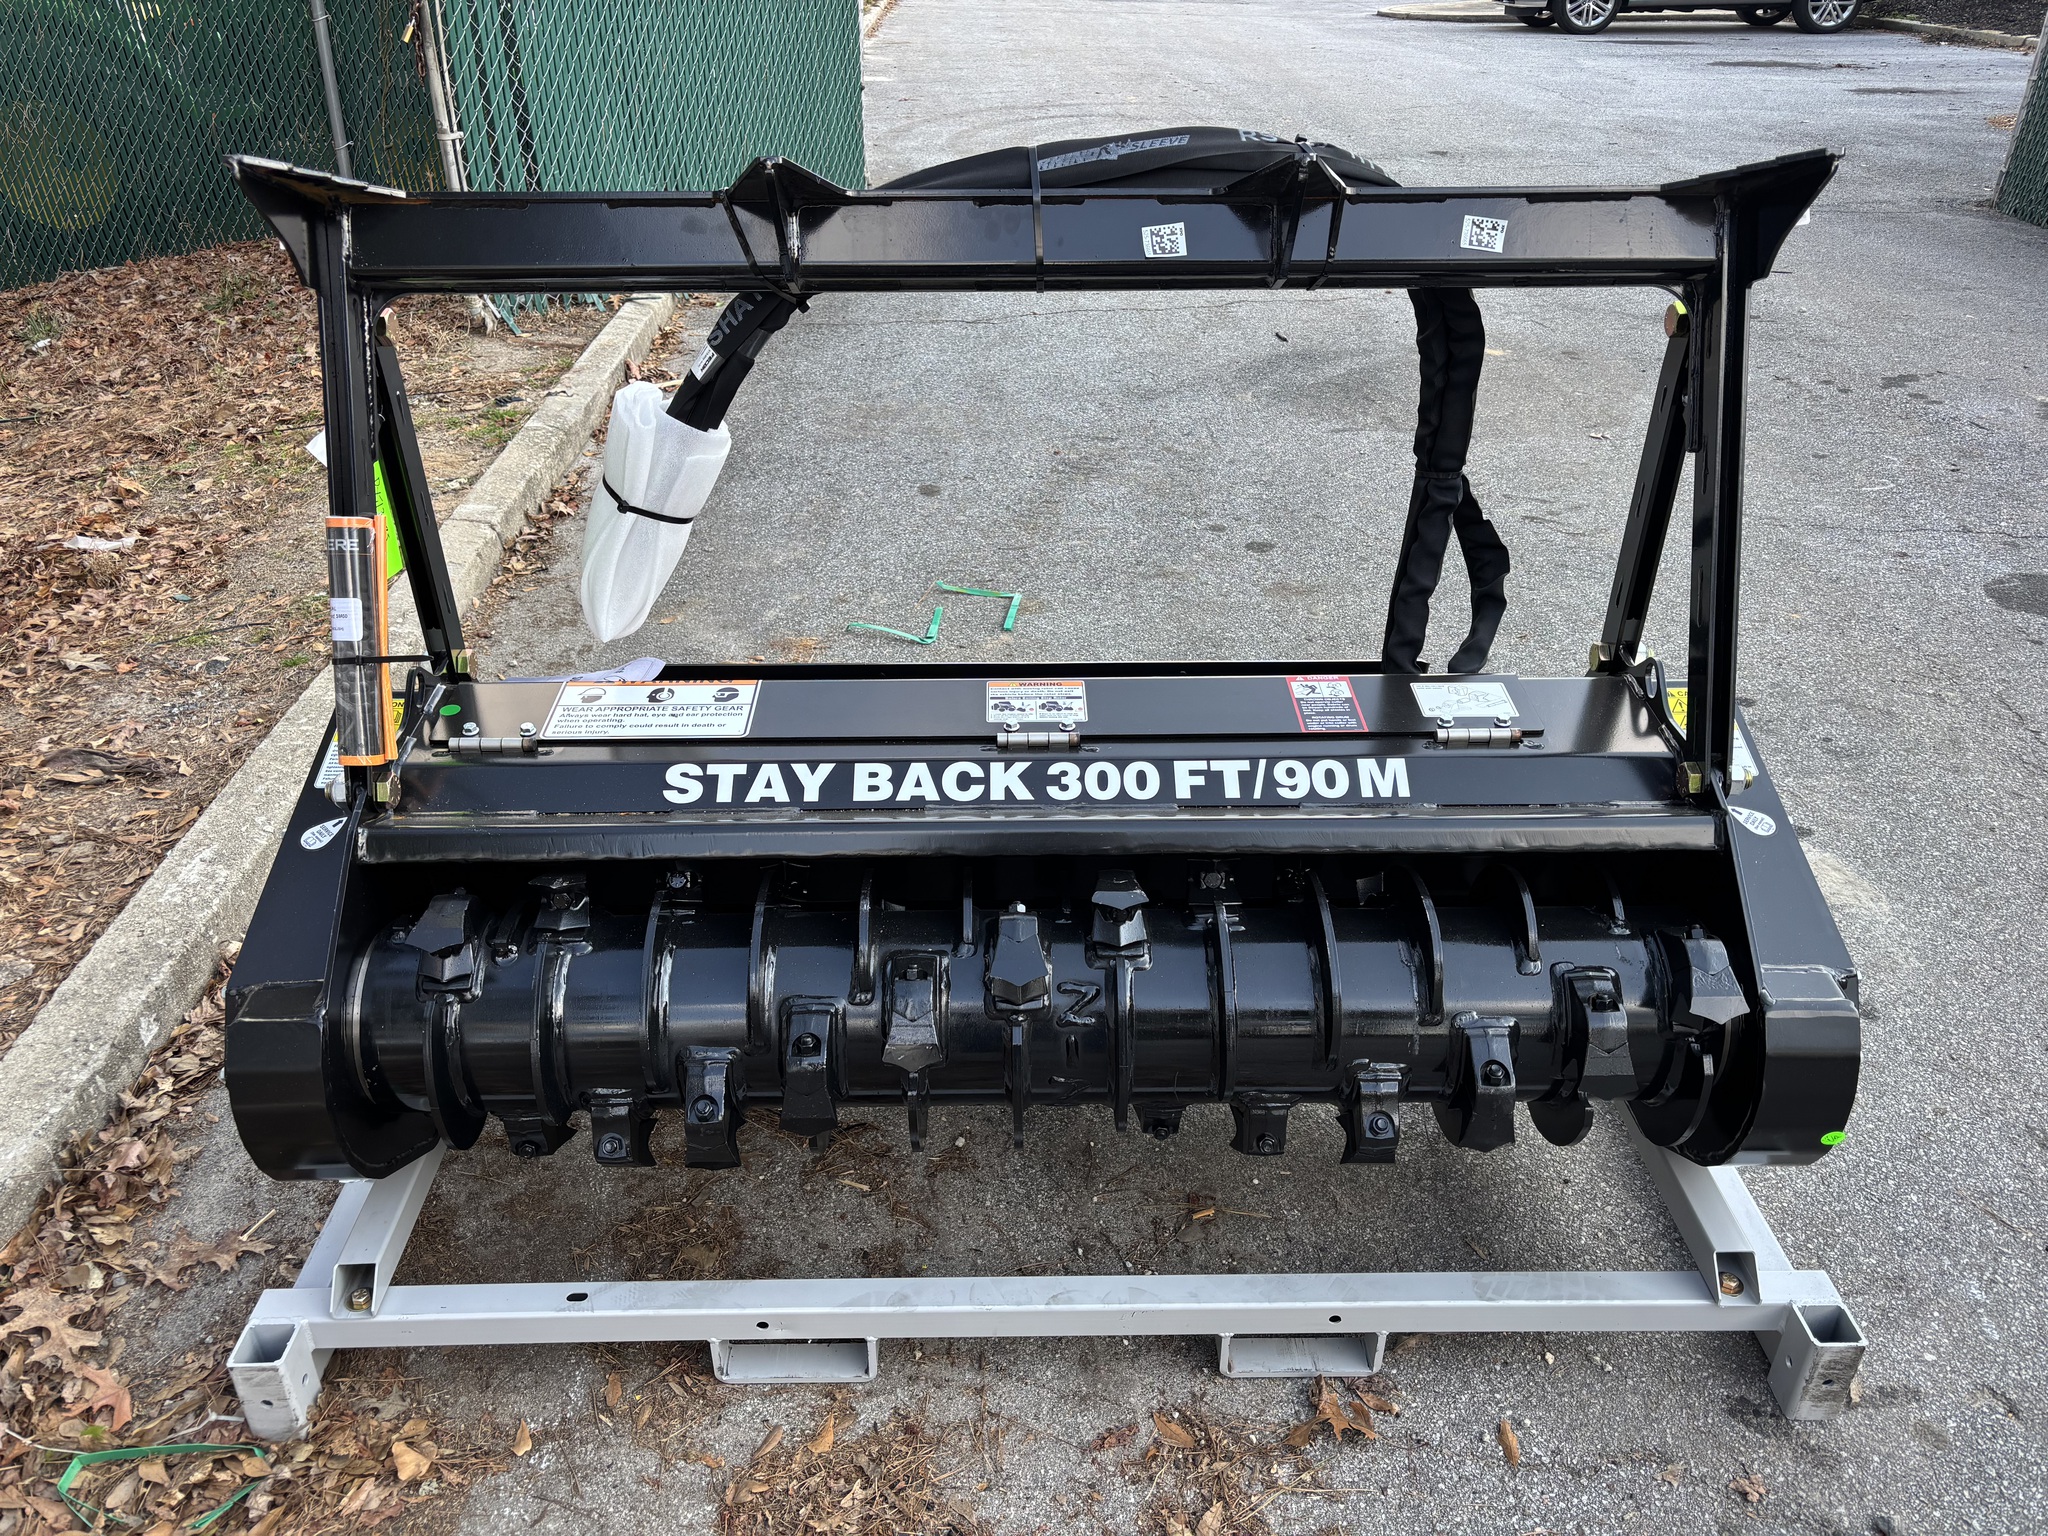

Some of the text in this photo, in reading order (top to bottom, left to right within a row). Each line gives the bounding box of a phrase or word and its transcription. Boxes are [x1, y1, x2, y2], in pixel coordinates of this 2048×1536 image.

[1129, 135, 1189, 151] SLEEVE
[663, 757, 1411, 803] STAY BACK 300 FT/90 M
[316, 829, 326, 838] DAILY
[320, 824, 334, 837] SERVICE
